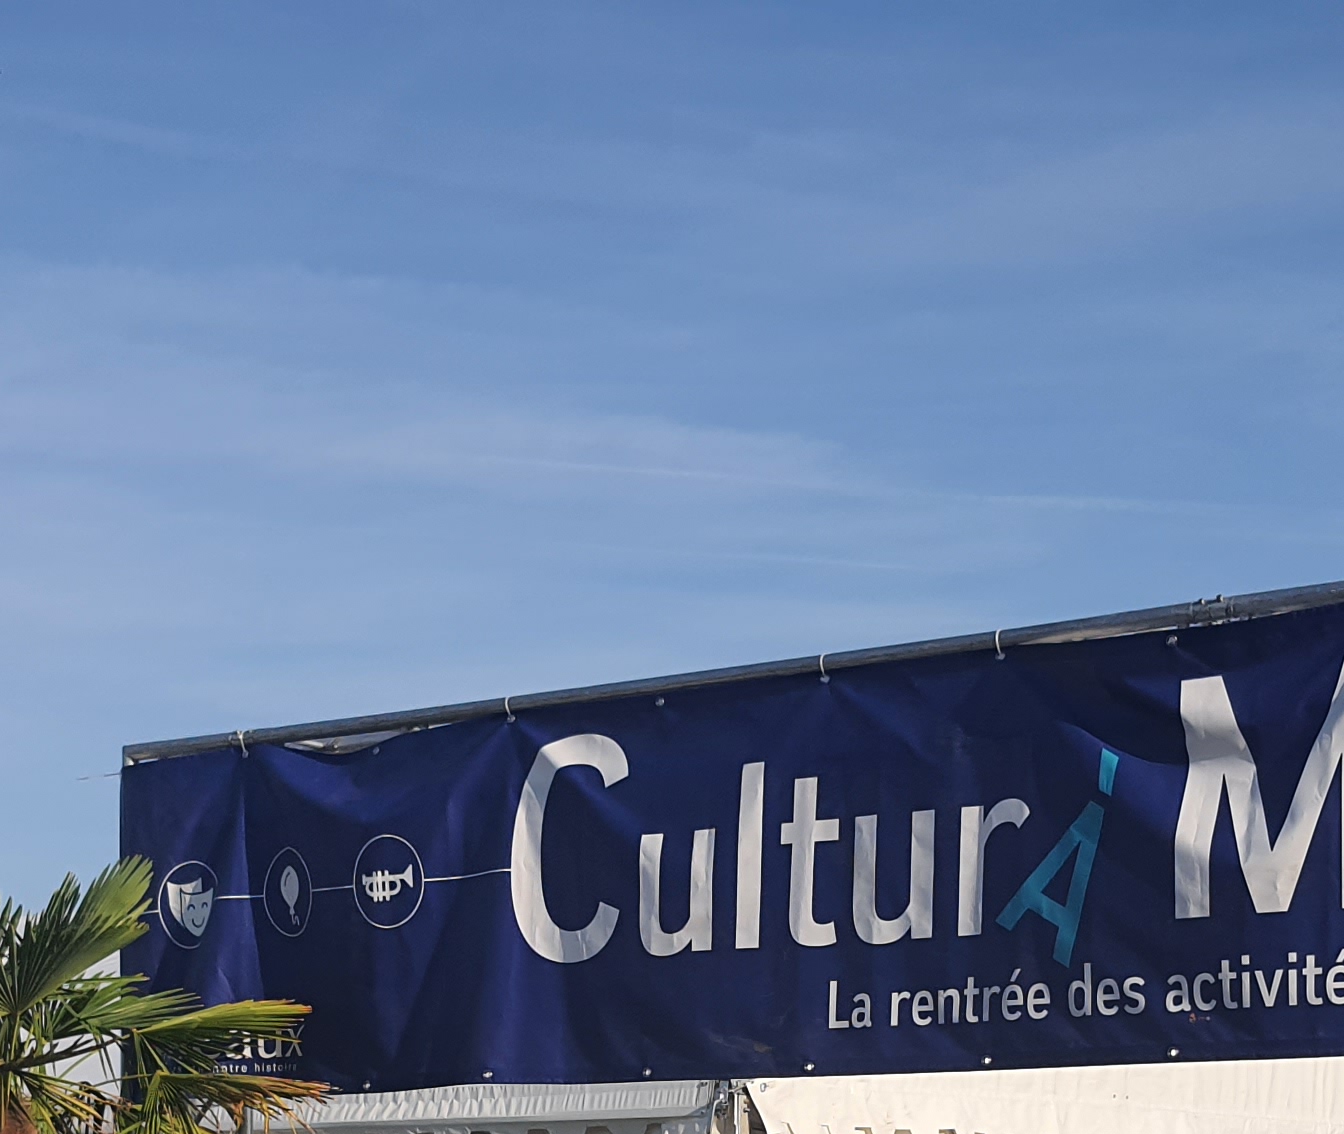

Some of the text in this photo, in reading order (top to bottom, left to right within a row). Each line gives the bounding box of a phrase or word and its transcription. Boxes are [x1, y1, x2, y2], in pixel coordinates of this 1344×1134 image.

[828, 980, 872, 1029] La
[889, 968, 1051, 1028] rentrée
[1068, 962, 1146, 1018] des
